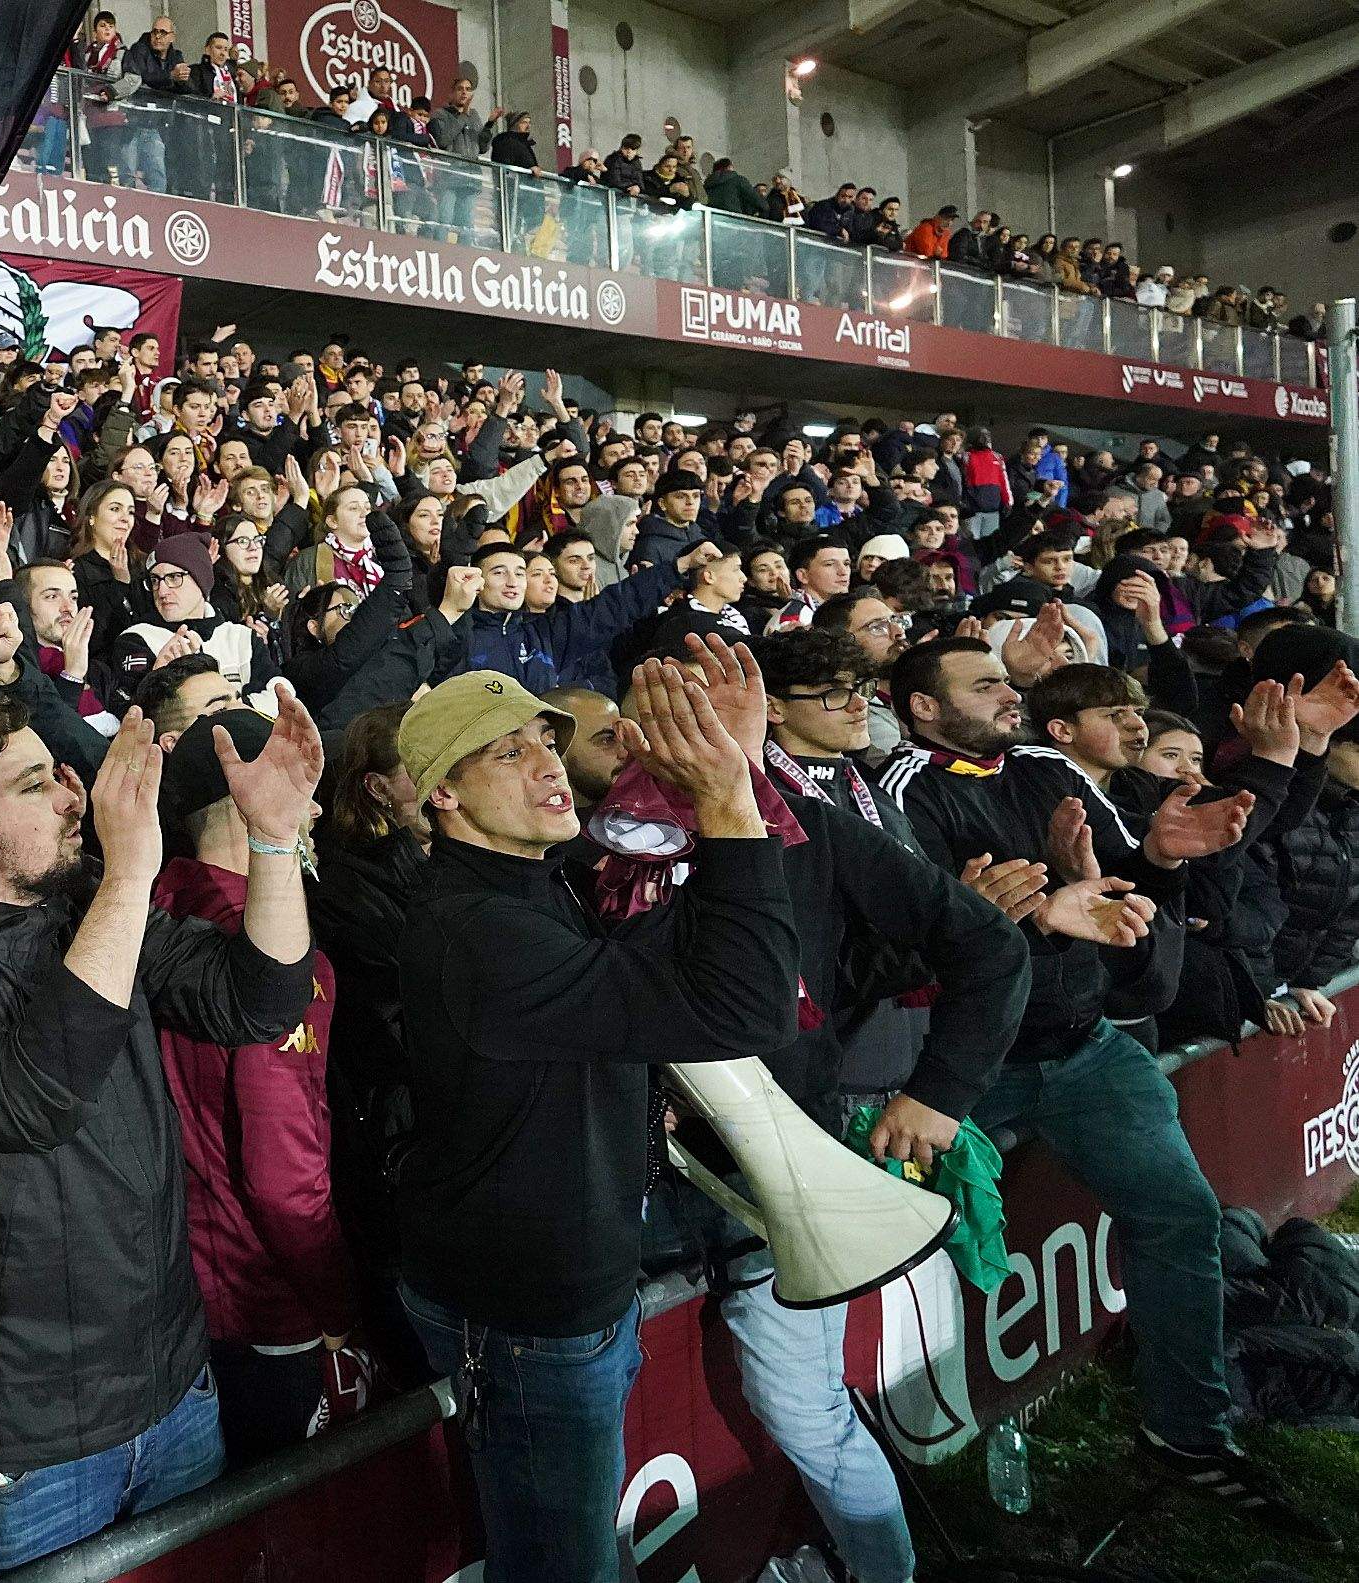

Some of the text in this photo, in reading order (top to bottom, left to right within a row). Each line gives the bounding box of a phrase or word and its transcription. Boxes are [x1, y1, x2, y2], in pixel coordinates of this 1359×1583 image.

[320, 22, 416, 77] Estrella
[315, 232, 590, 321] Estrella Galicia
[710, 292, 802, 337] PUMAR
[835, 312, 911, 354] Arrital
[808, 765, 835, 780] HH
